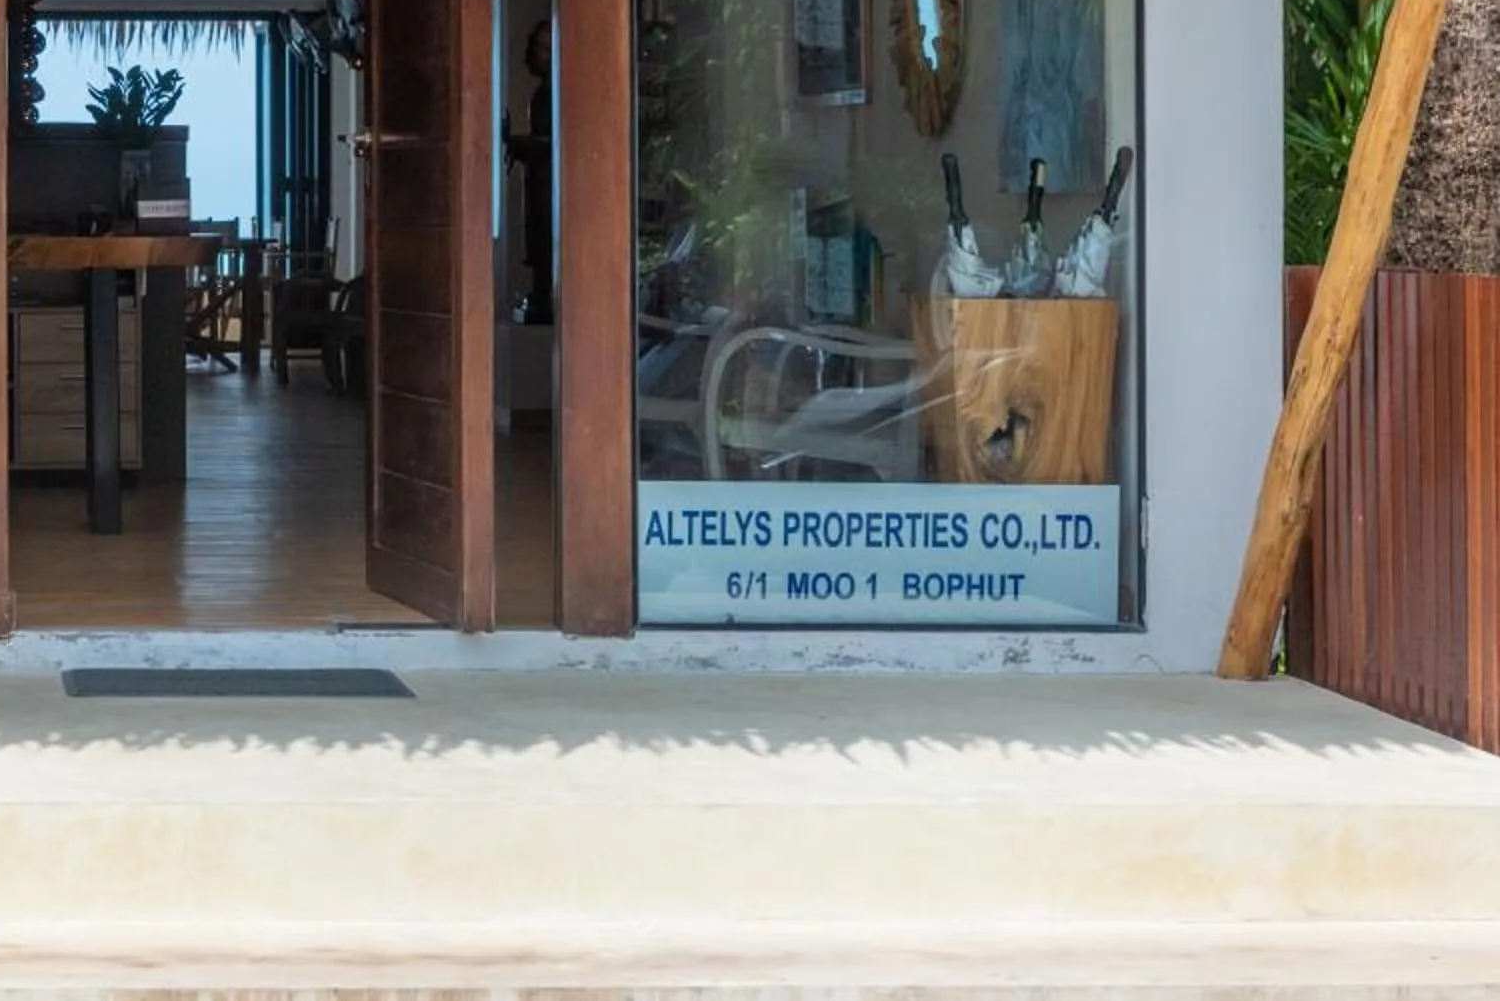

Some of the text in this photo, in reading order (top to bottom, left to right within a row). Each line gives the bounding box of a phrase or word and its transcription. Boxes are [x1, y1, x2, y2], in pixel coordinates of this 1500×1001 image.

[645, 510, 1100, 555] ALTELYS PROPERTIES CO.,LTD.
[726, 571, 1025, 600] 6/1 MOO 1 BOPHUT
